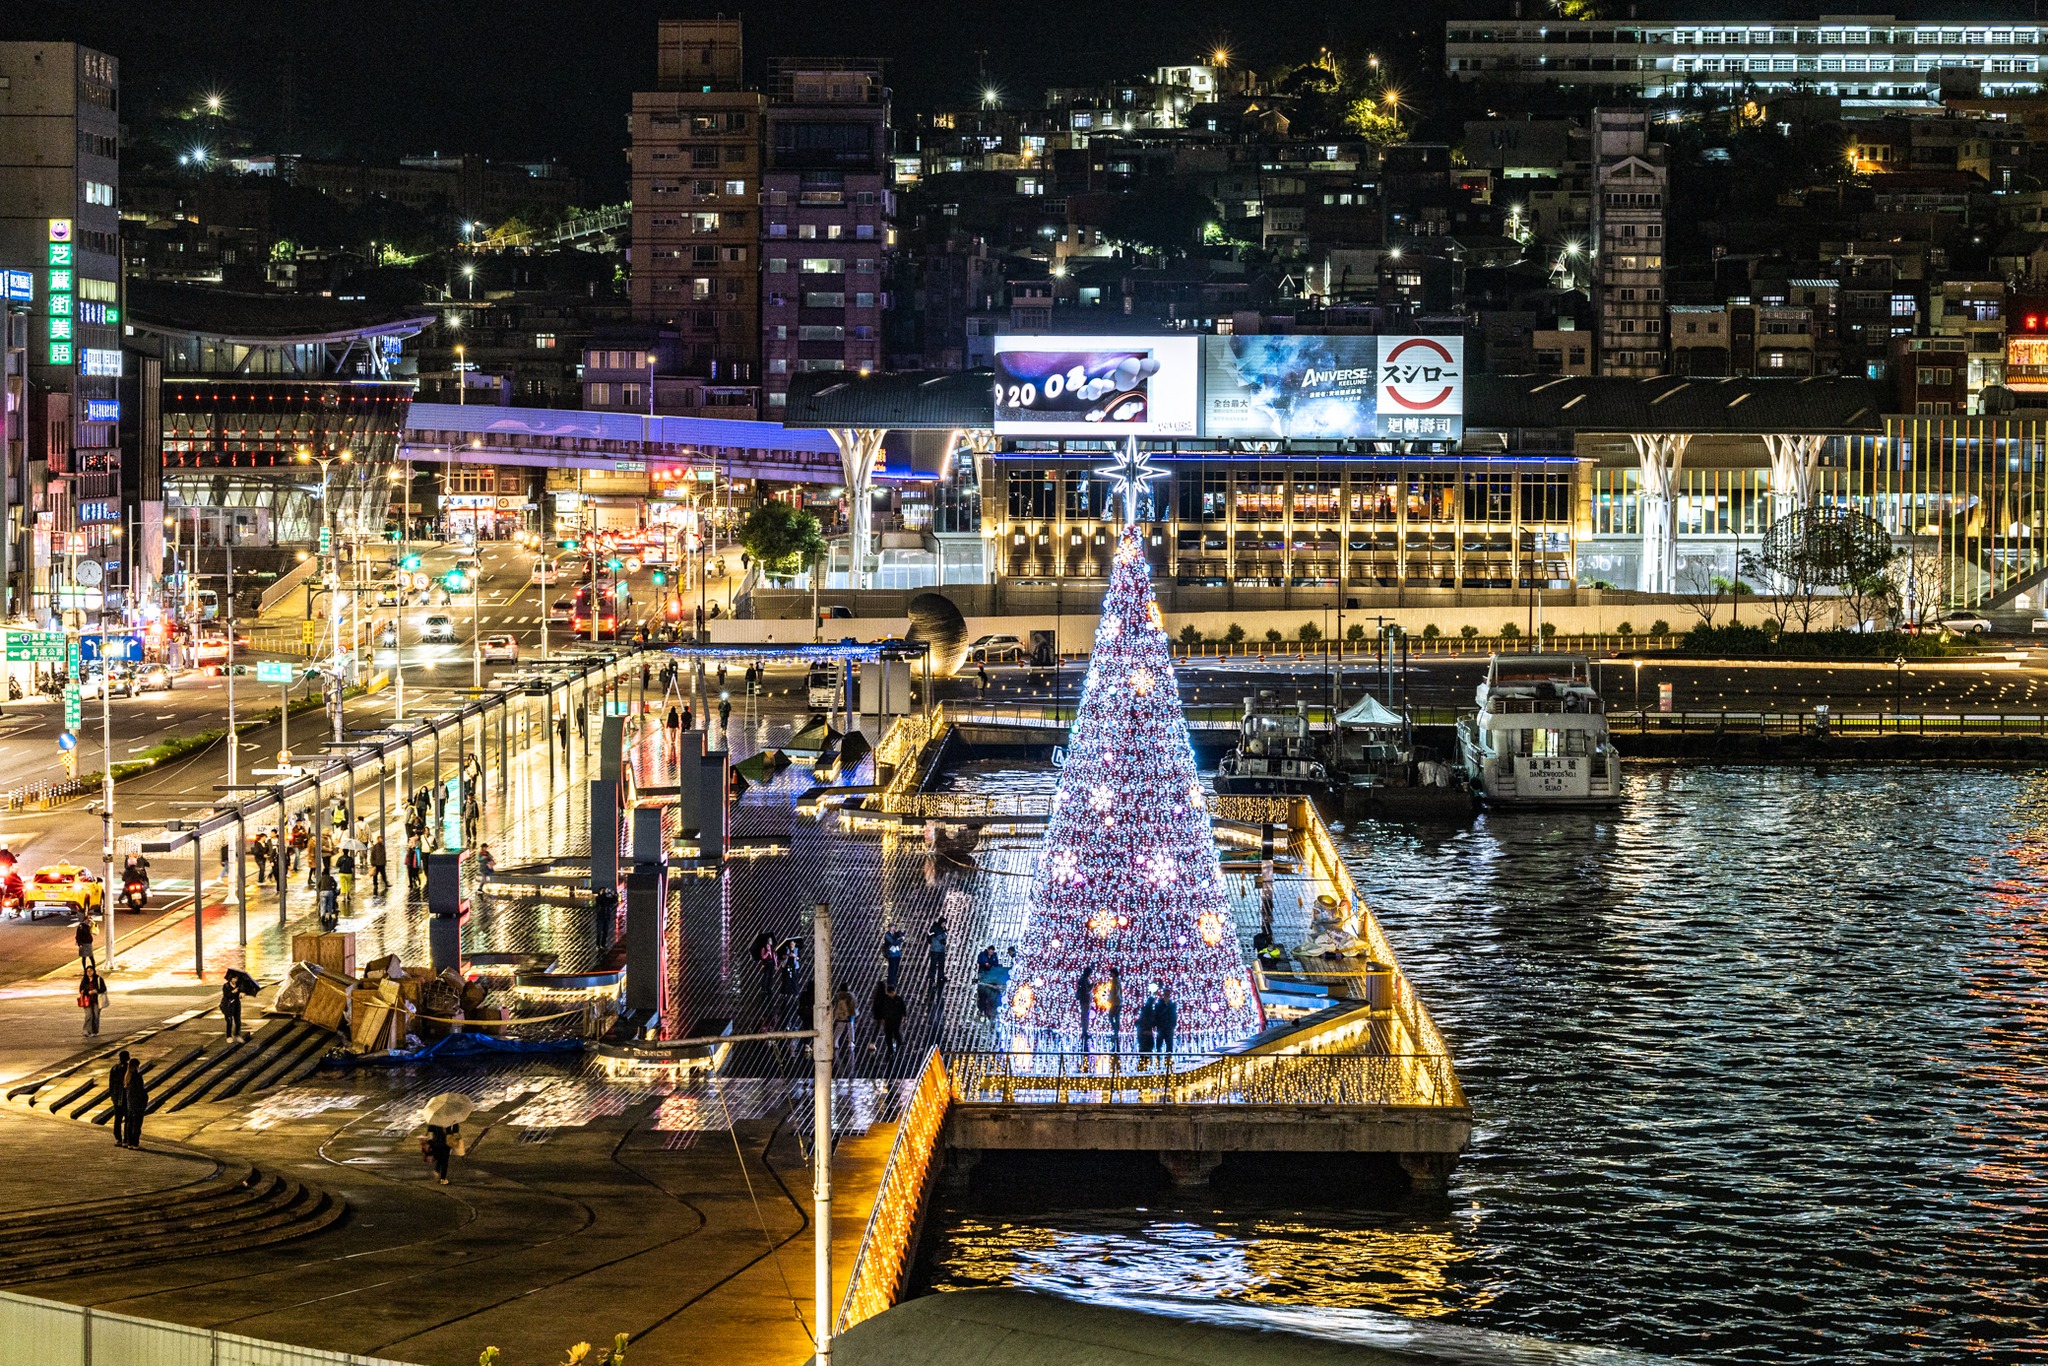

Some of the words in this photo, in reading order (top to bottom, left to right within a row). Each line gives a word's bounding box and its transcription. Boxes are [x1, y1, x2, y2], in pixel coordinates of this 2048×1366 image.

[1301, 368, 1368, 387] ANIVERSE
[1381, 365, 1458, 383] スシロー
[1008, 383, 1036, 407] 20
[1214, 400, 1248, 408] 全台最大
[1388, 417, 1451, 433] 迴轉壽司
